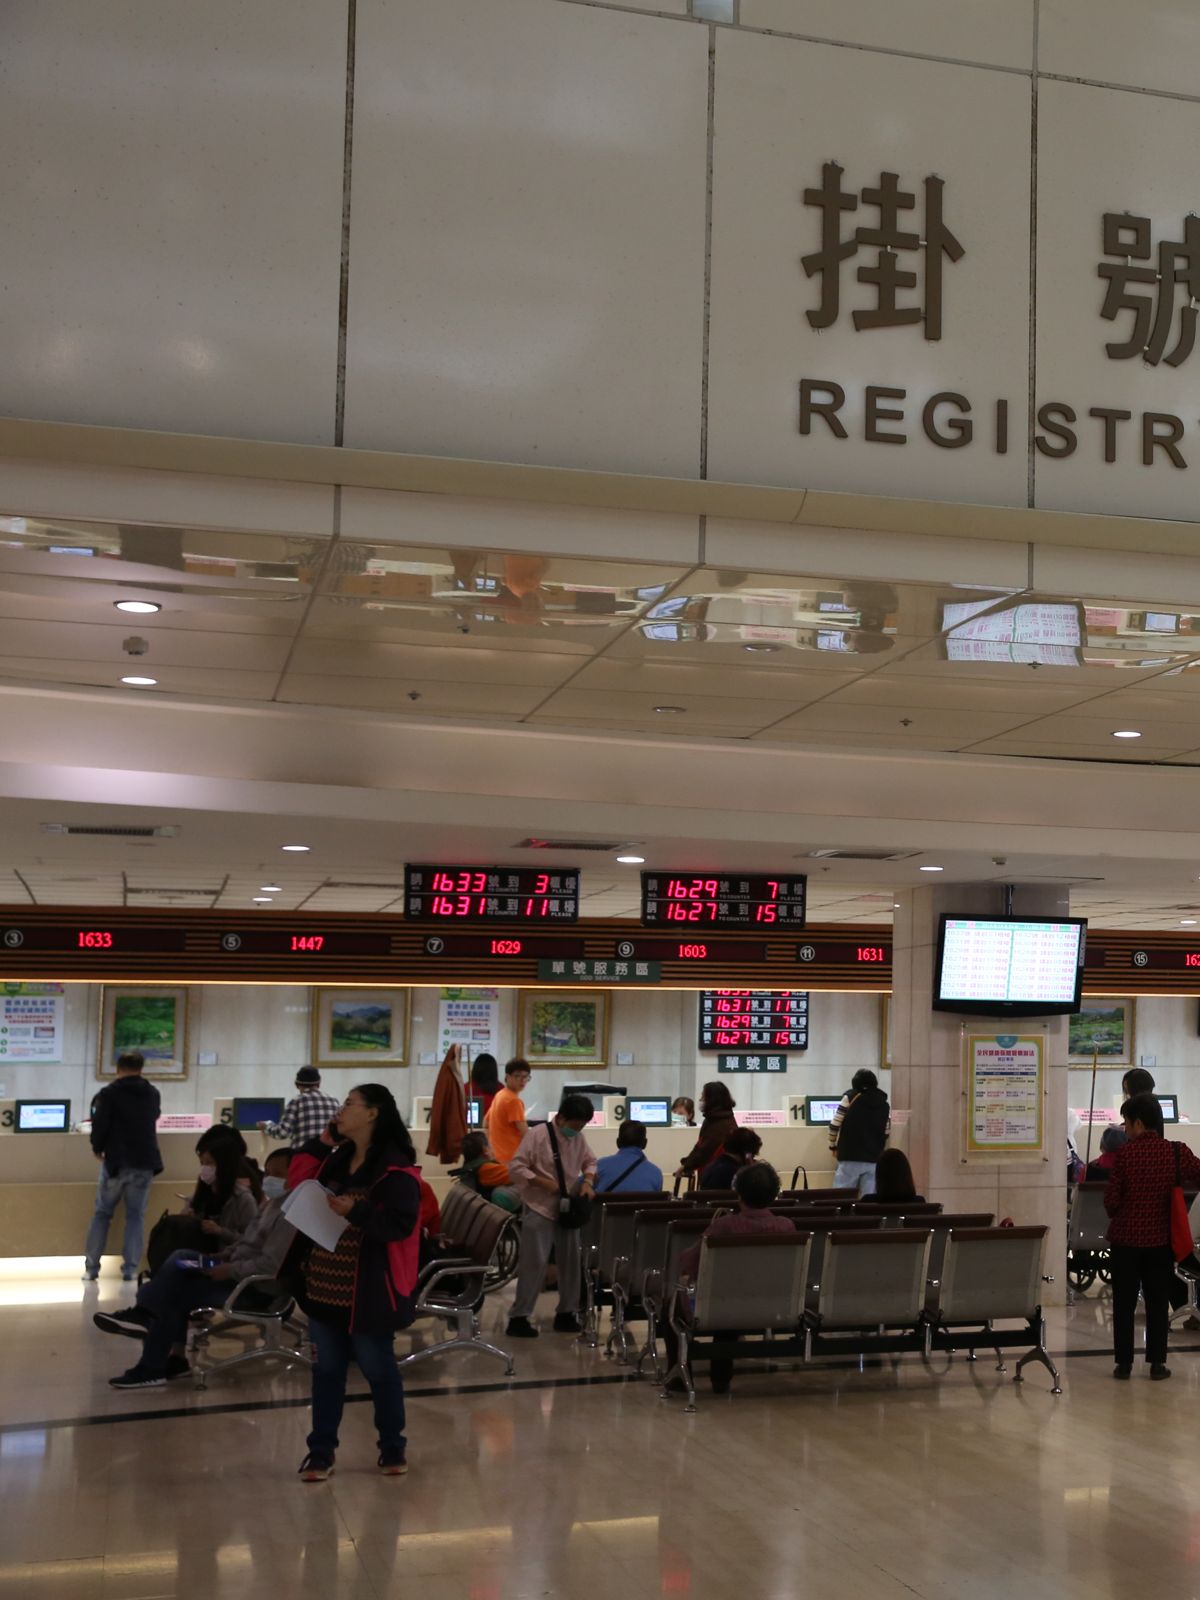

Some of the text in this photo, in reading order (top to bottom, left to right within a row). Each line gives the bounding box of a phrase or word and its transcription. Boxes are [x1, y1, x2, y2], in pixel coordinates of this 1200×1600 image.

[432, 872, 487, 893] 1633
[534, 874, 549, 894] 3
[667, 880, 718, 899] 1629
[767, 882, 778, 900] 7
[432, 896, 486, 915] 1631
[525, 898, 548, 916] 11
[667, 902, 718, 921] 1627
[756, 904, 777, 922] 15
[78, 932, 112, 948] 1633
[291, 936, 323, 950] 1447
[491, 940, 521, 954] 1629
[678, 944, 707, 958] 1603
[857, 947, 884, 961] 1631
[552, 961, 648, 976] 單號服務區
[717, 999, 790, 1012] 1631 11
[716, 1015, 789, 1028] 1629 7
[716, 1031, 789, 1044] 1627 15
[725, 1056, 780, 1070] 單號區
[1, 1110, 13, 1127] 3
[220, 1107, 233, 1124] 5
[614, 1105, 625, 1120] 9
[790, 1105, 806, 1120] 11
